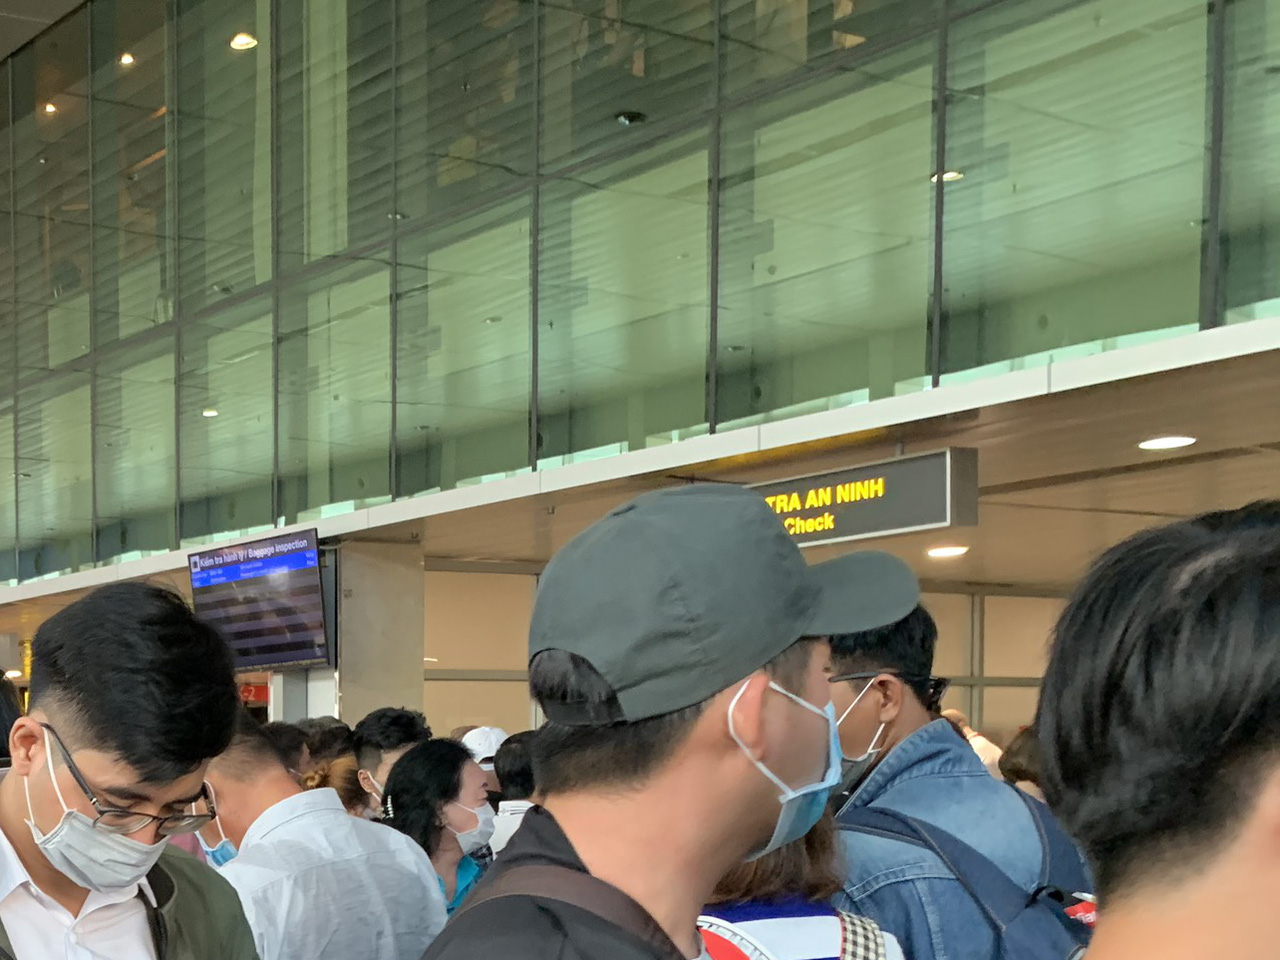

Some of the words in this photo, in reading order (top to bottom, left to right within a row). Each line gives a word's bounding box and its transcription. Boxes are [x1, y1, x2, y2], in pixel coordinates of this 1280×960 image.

[805, 487, 832, 509] AN
[836, 477, 885, 504] NINH
[784, 512, 835, 535] Check
[248, 547, 275, 560] Baggage
[276, 539, 307, 553] inspection
